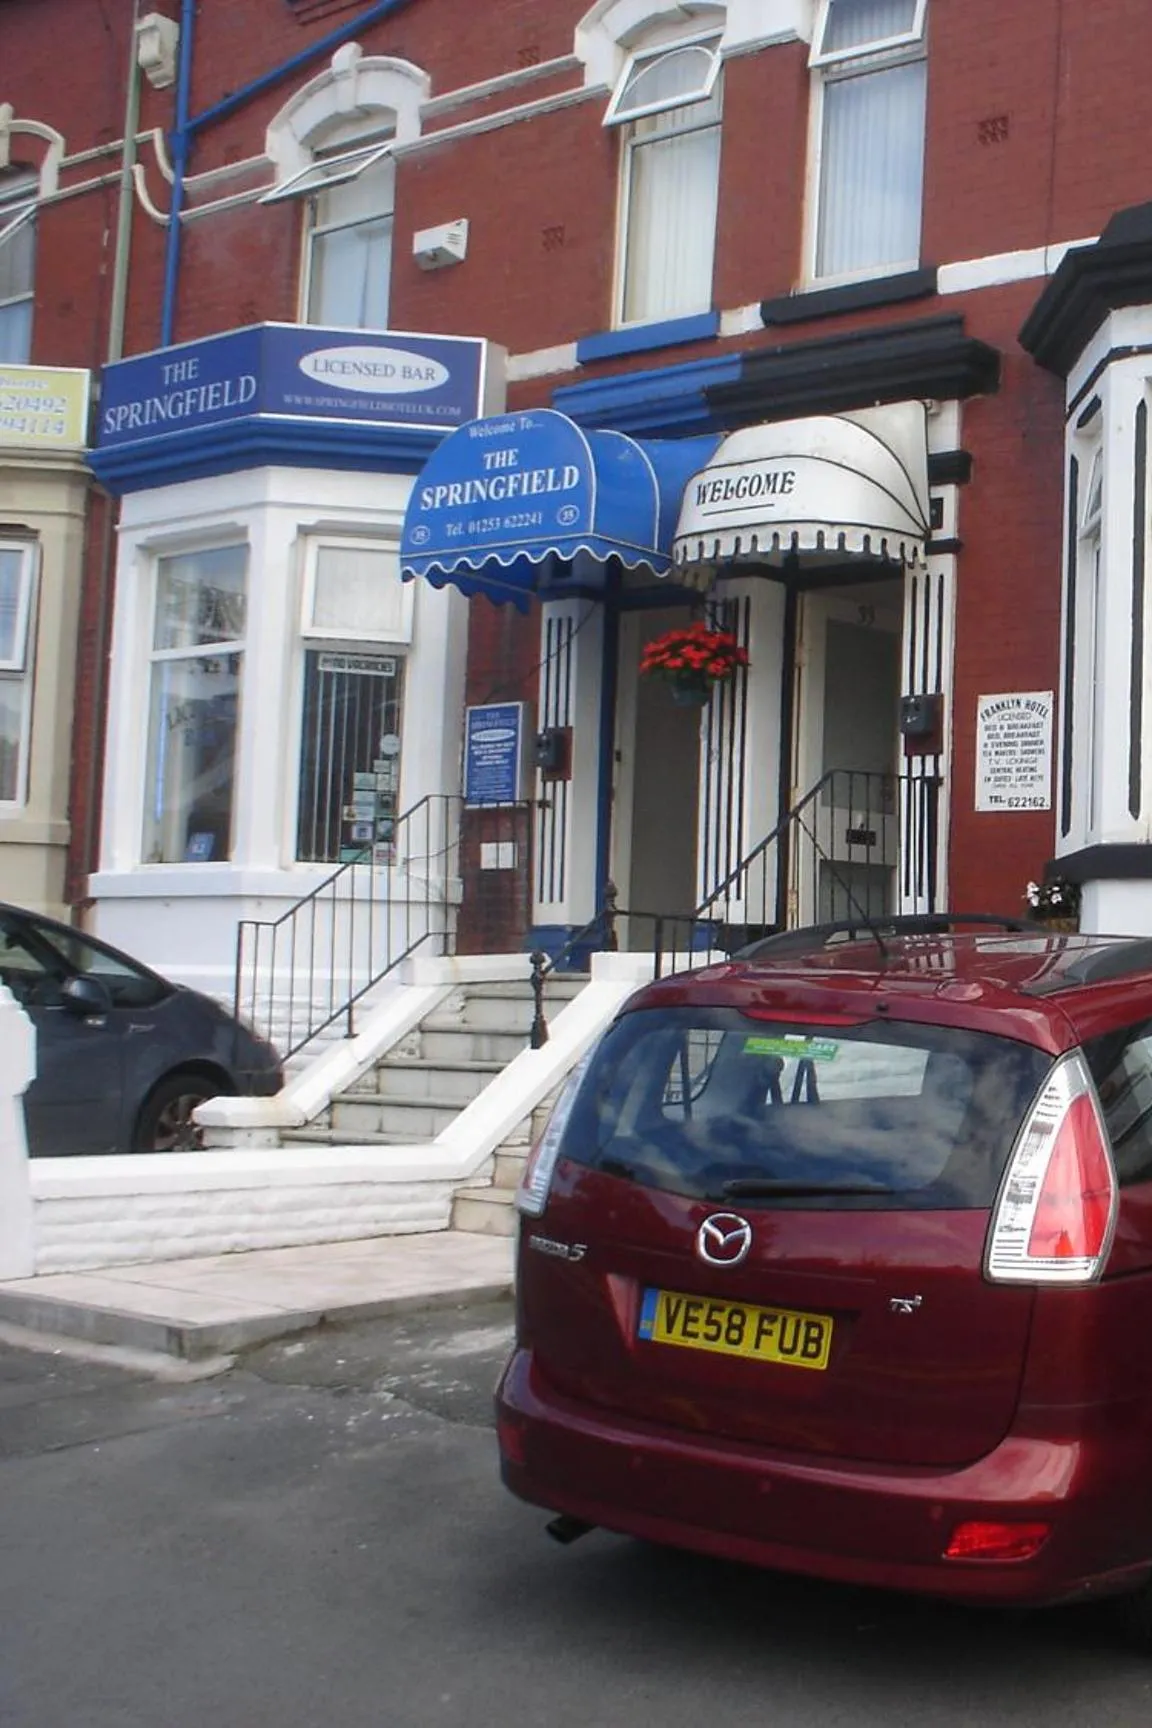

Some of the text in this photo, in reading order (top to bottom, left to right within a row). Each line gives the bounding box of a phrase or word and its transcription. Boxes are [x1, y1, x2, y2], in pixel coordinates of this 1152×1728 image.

[162, 358, 200, 385] THE
[312, 358, 436, 381] LICENSED BAR
[103, 374, 257, 434] SPRINGFIELD
[483, 448, 520, 470] THE
[420, 465, 580, 511] SPRINGFIELD
[695, 470, 796, 506] WELCOME
[468, 519, 500, 534] 01253
[503, 512, 543, 529] 622241
[1008, 796, 1046, 808] 622162
[665, 1296, 824, 1360] VE58 FUB
